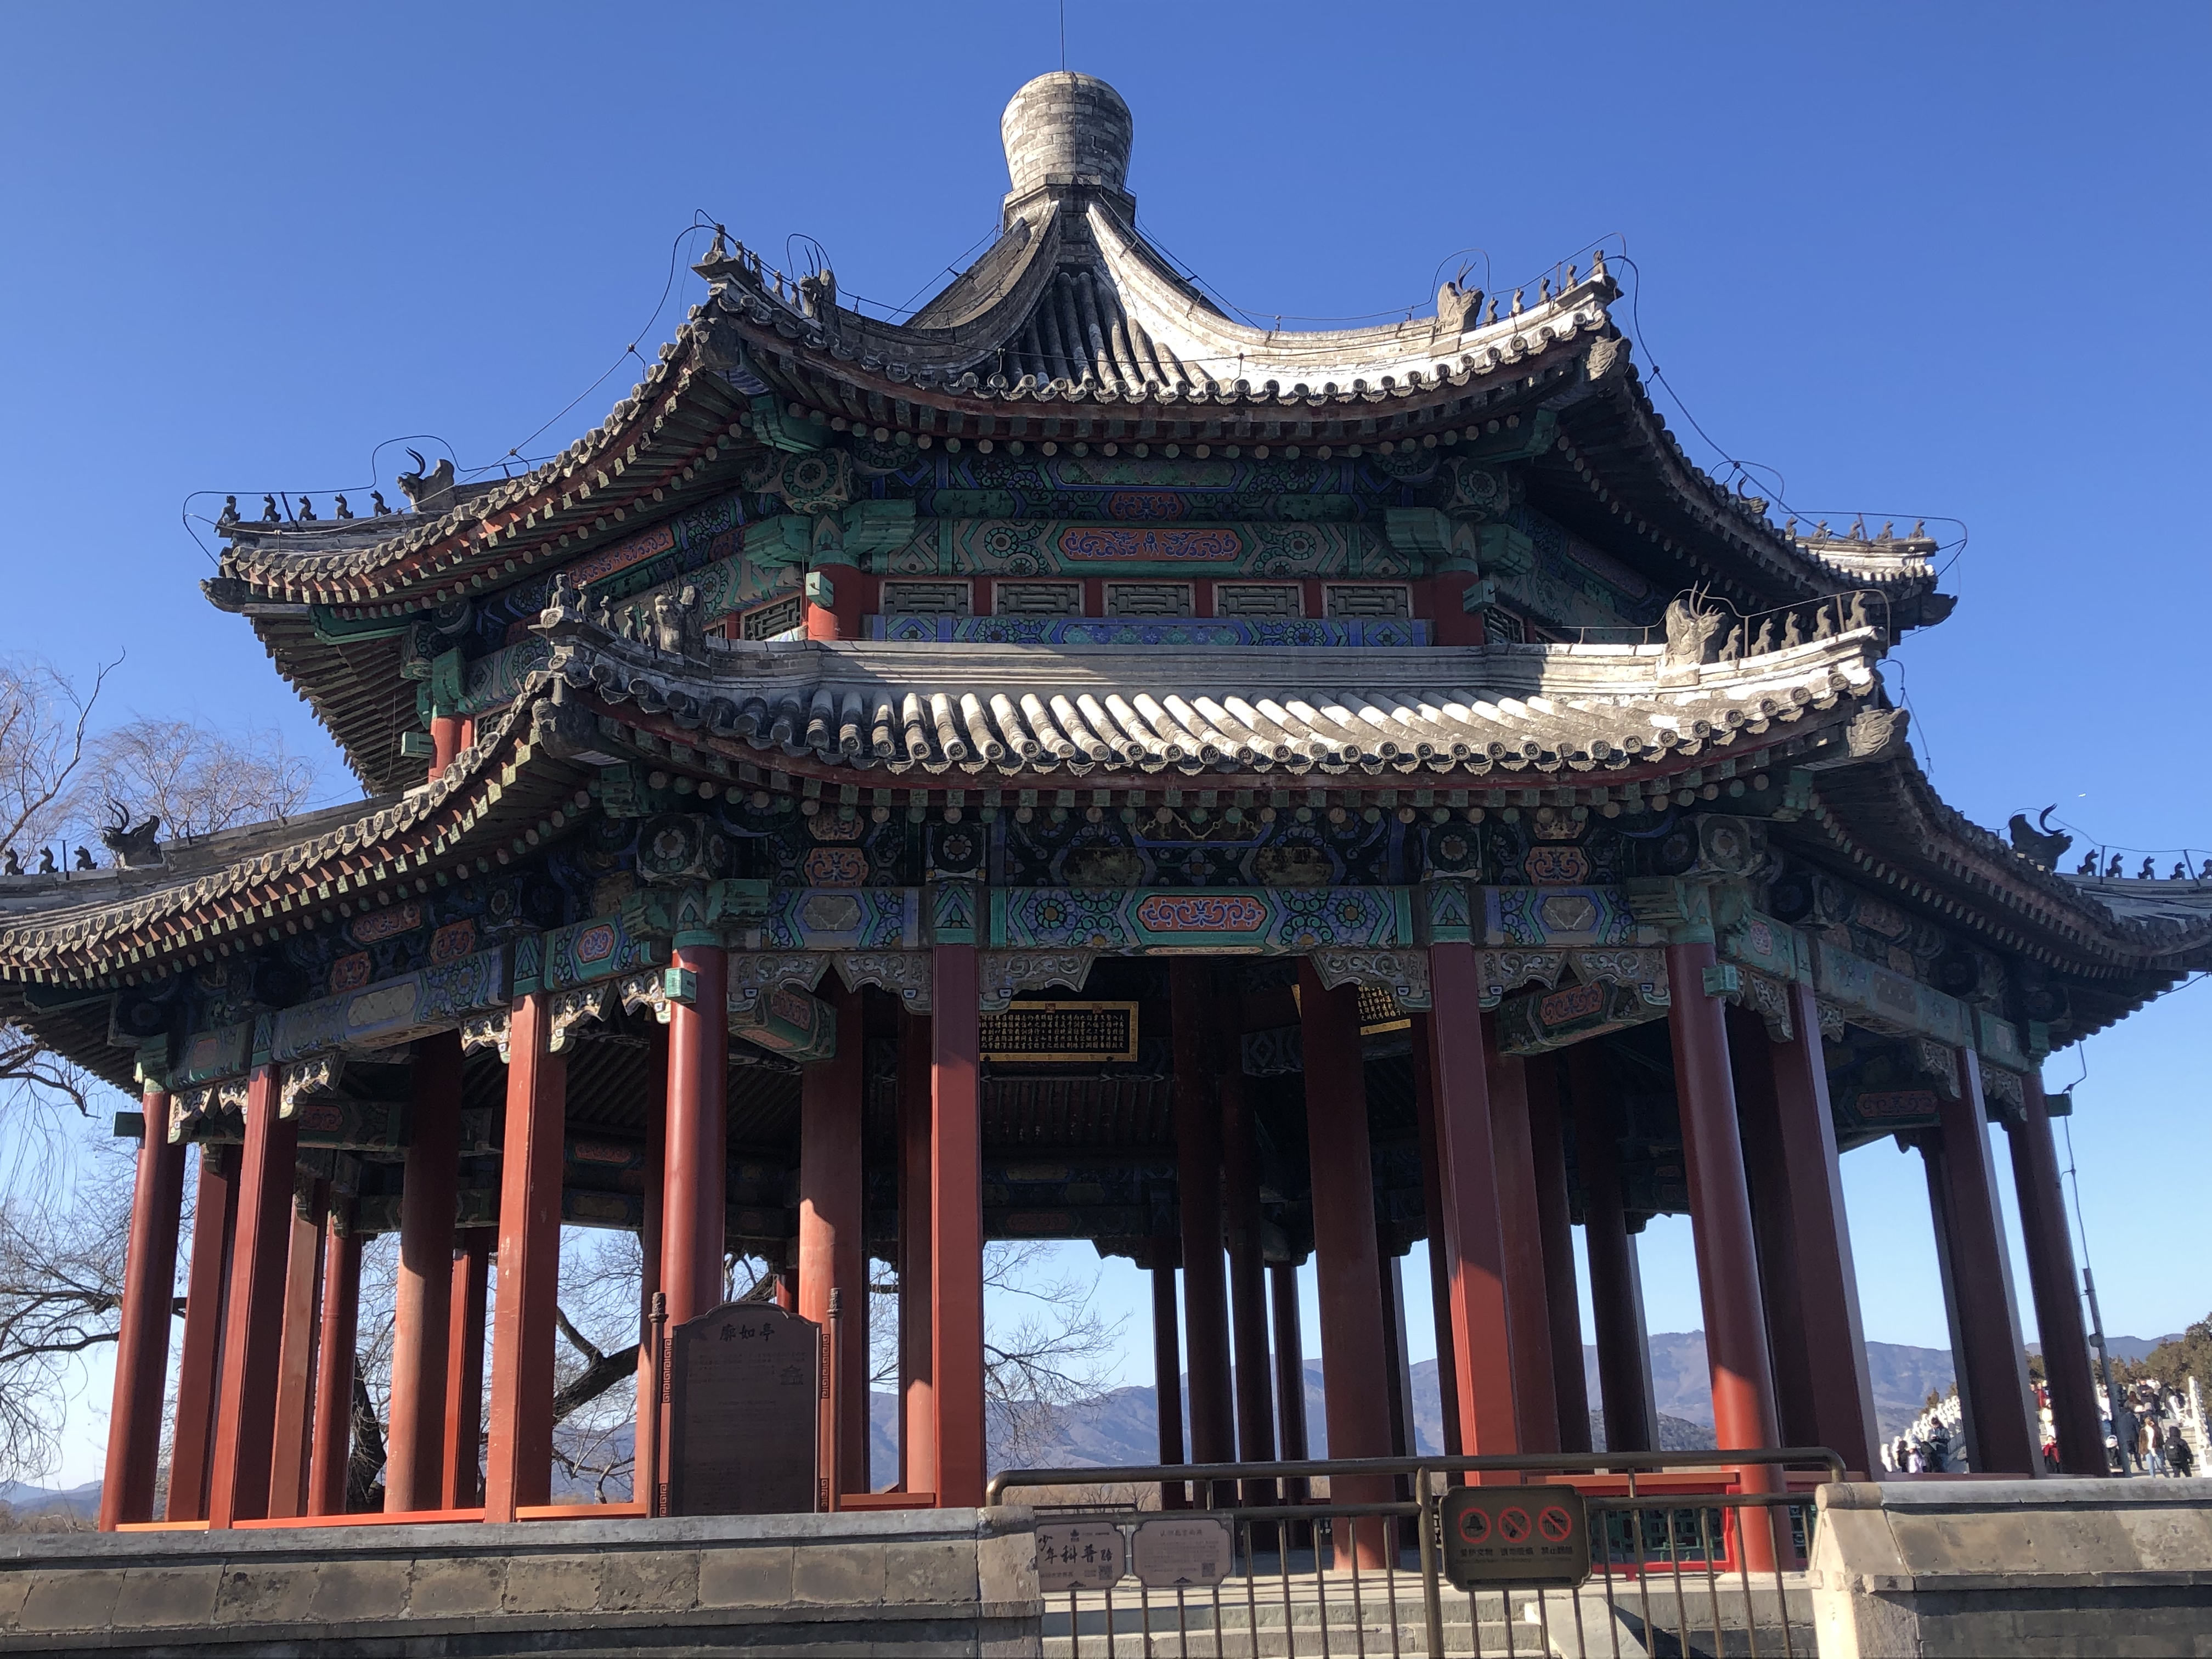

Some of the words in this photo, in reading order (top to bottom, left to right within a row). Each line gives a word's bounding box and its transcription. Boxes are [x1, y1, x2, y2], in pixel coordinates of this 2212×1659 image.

[719, 1323, 775, 1341] 廓如亭
[1037, 1534, 1113, 1565] 少年科普路
